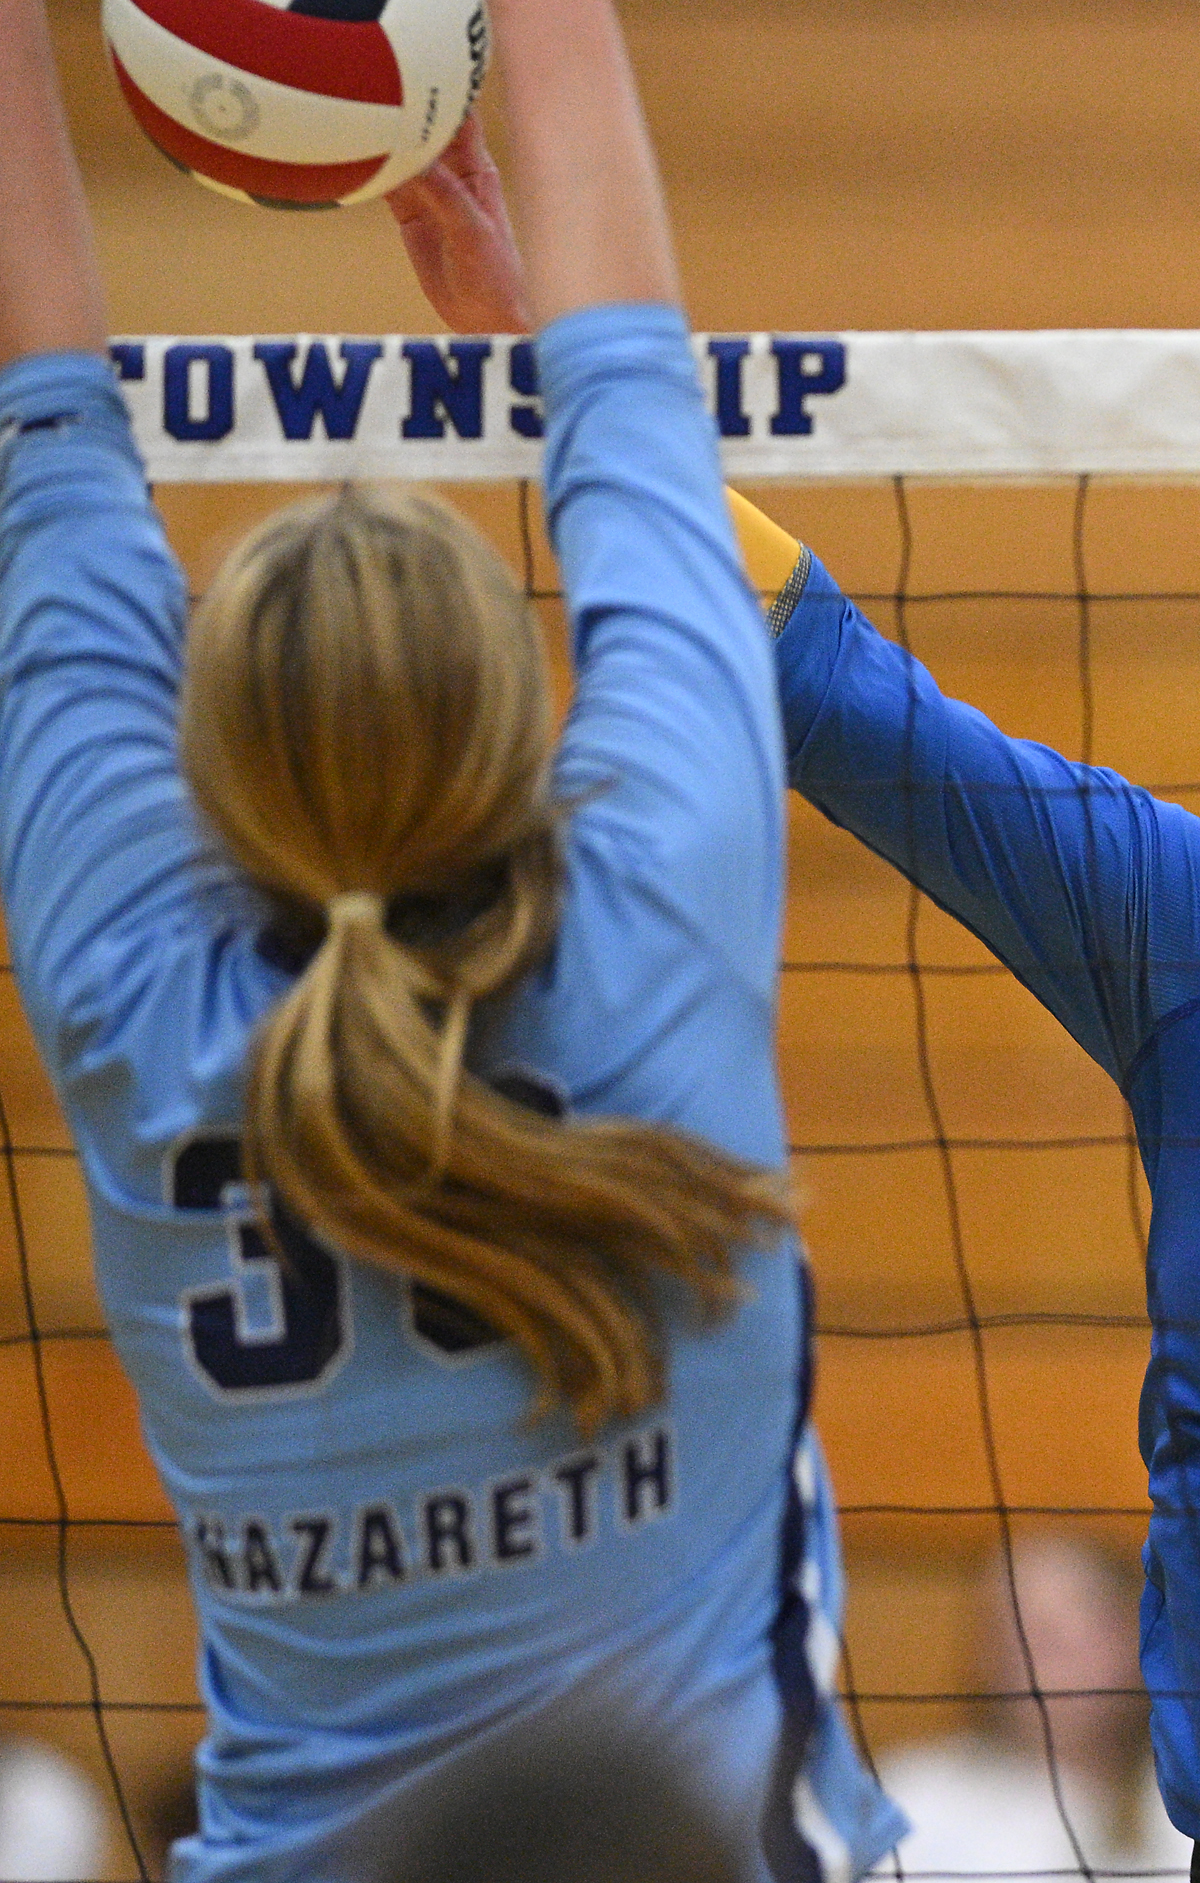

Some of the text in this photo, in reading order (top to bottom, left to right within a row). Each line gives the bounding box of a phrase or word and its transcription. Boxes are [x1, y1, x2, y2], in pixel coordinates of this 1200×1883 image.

[110, 341, 846, 441] OWNIP
[165, 1072, 567, 1400] 3
[196, 1429, 673, 1594] NAZARETH
